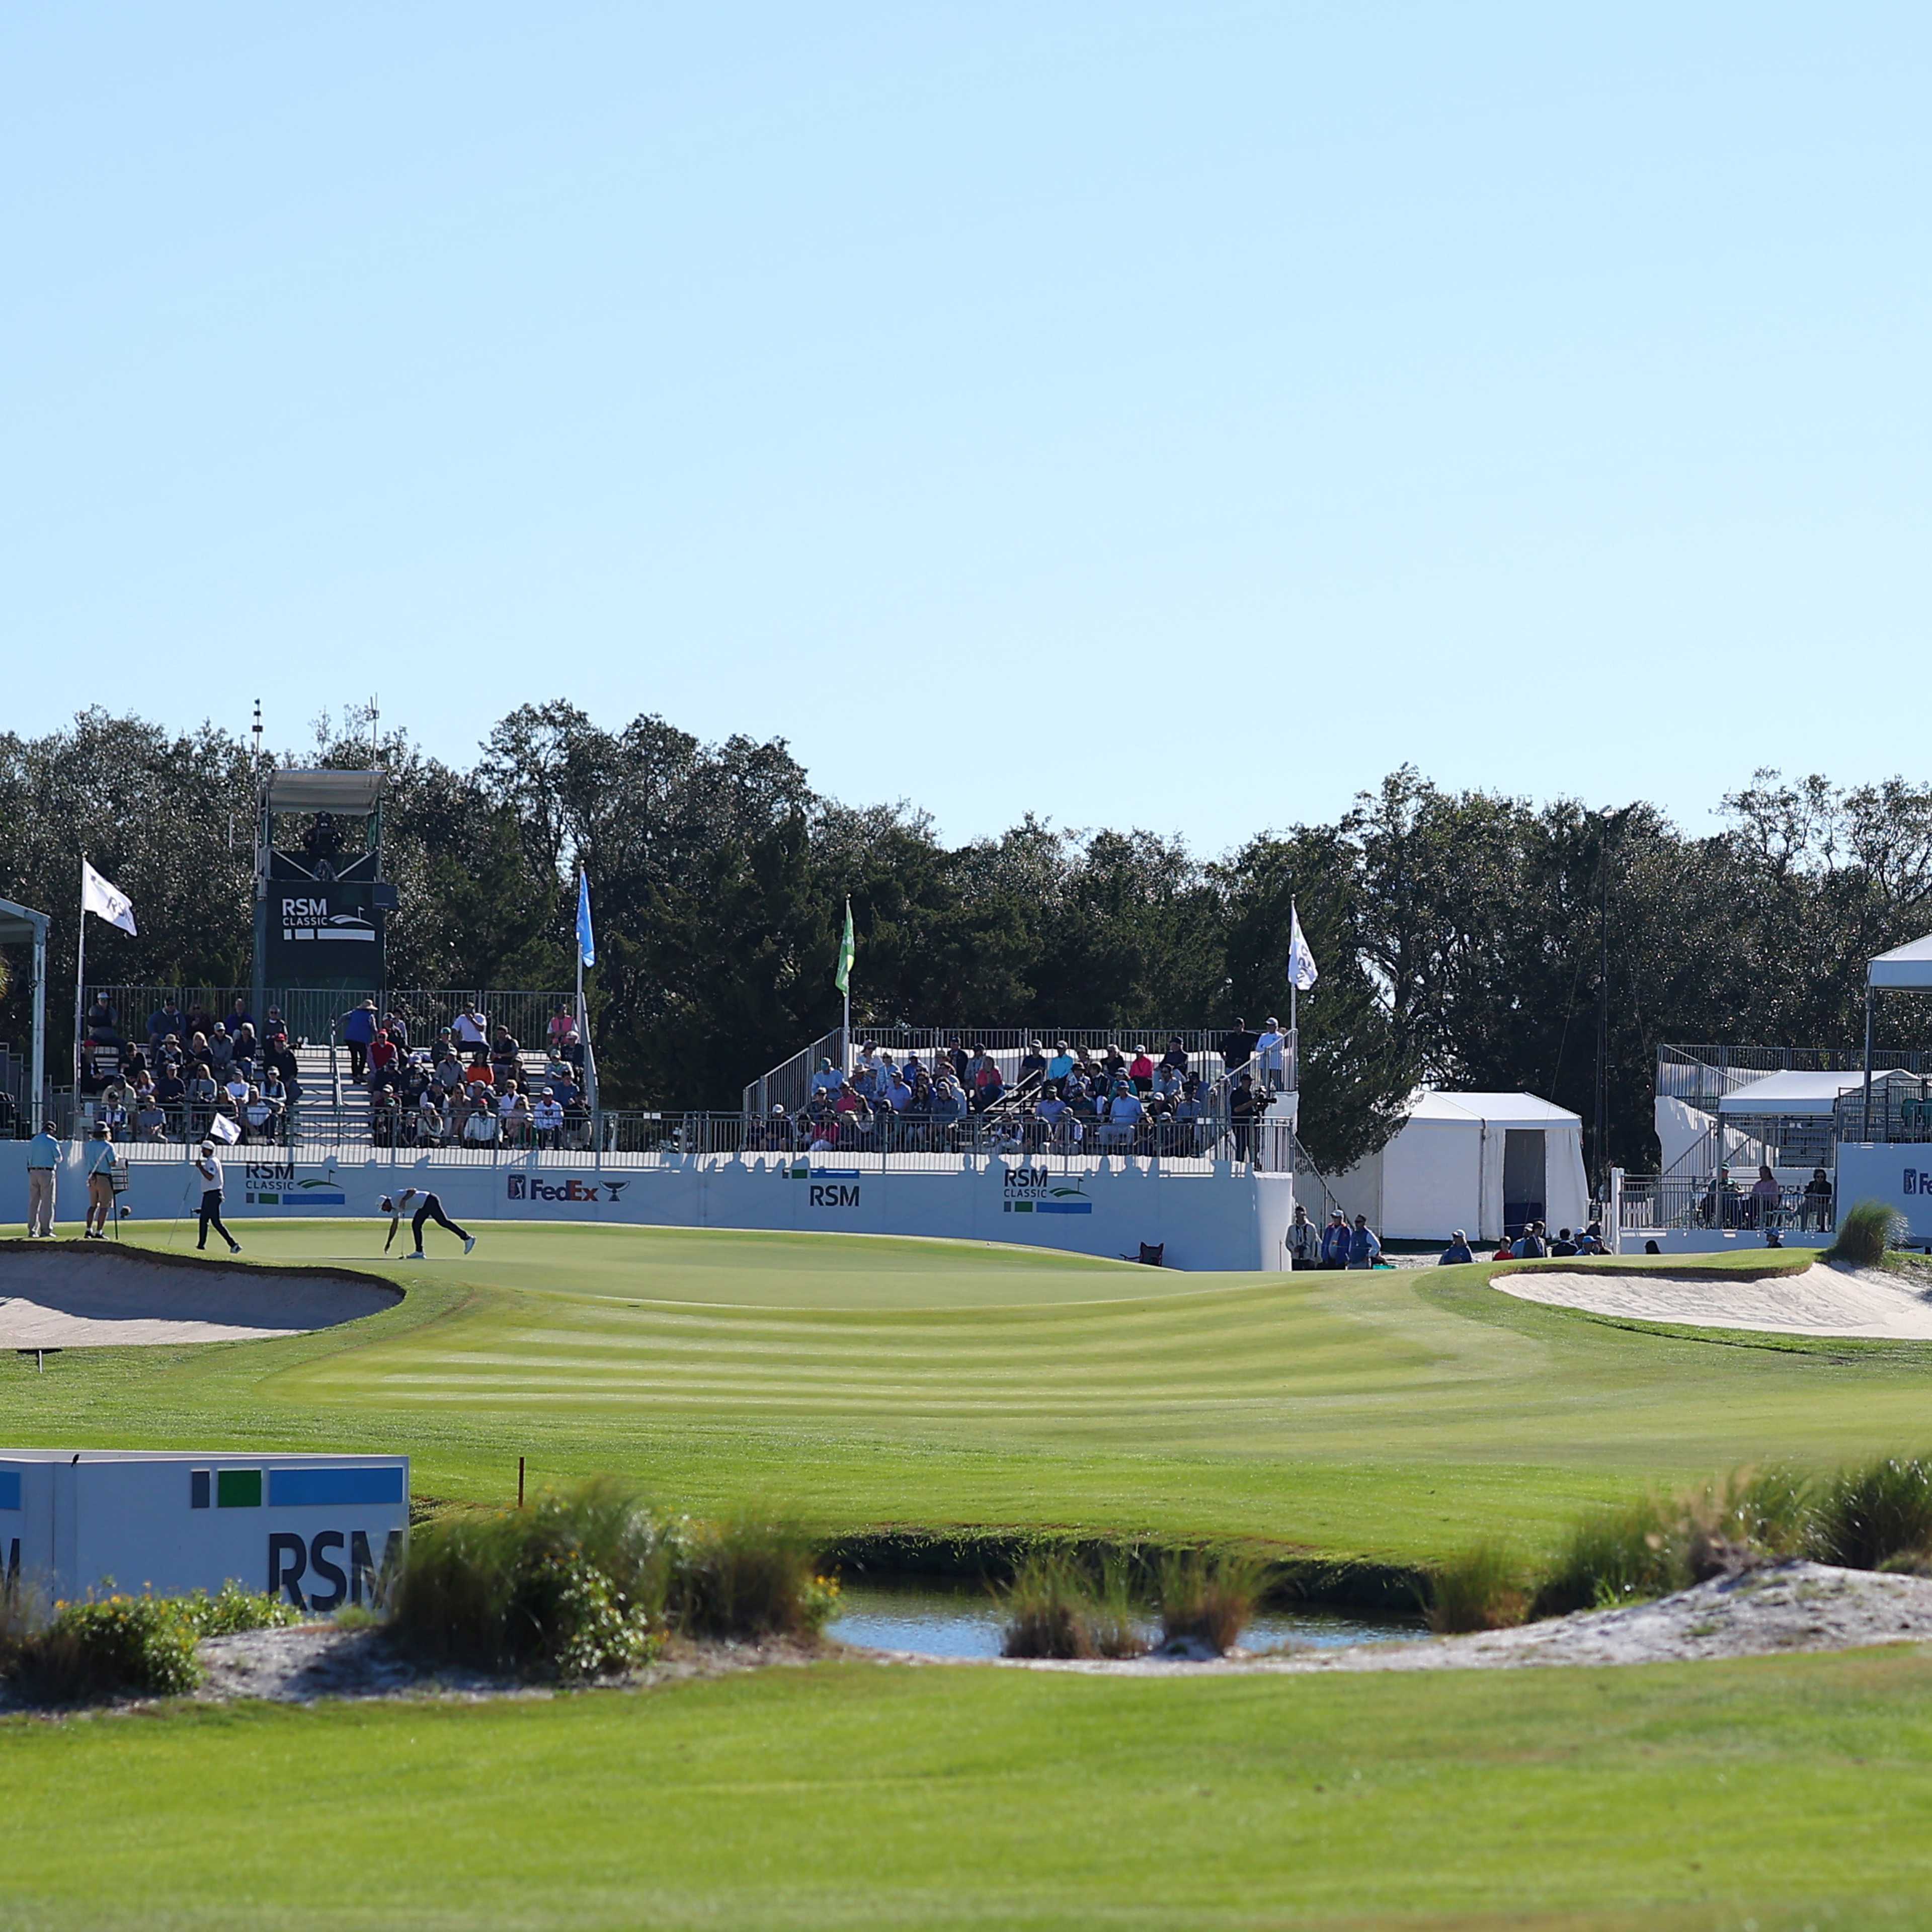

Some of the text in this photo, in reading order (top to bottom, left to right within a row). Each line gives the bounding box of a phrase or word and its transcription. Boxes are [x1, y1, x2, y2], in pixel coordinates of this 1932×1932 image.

[282, 899, 327, 916] RSM
[283, 917, 328, 926] CLASSIC
[246, 1161, 294, 1180] RSM
[1004, 1169, 1048, 1187] RSM
[246, 1180, 294, 1190] CLASSIC
[530, 1179, 599, 1201] FedEx
[1004, 1189, 1047, 1198] CLASSIC
[810, 1185, 860, 1206] RSM
[269, 1530, 403, 1612] RSM
